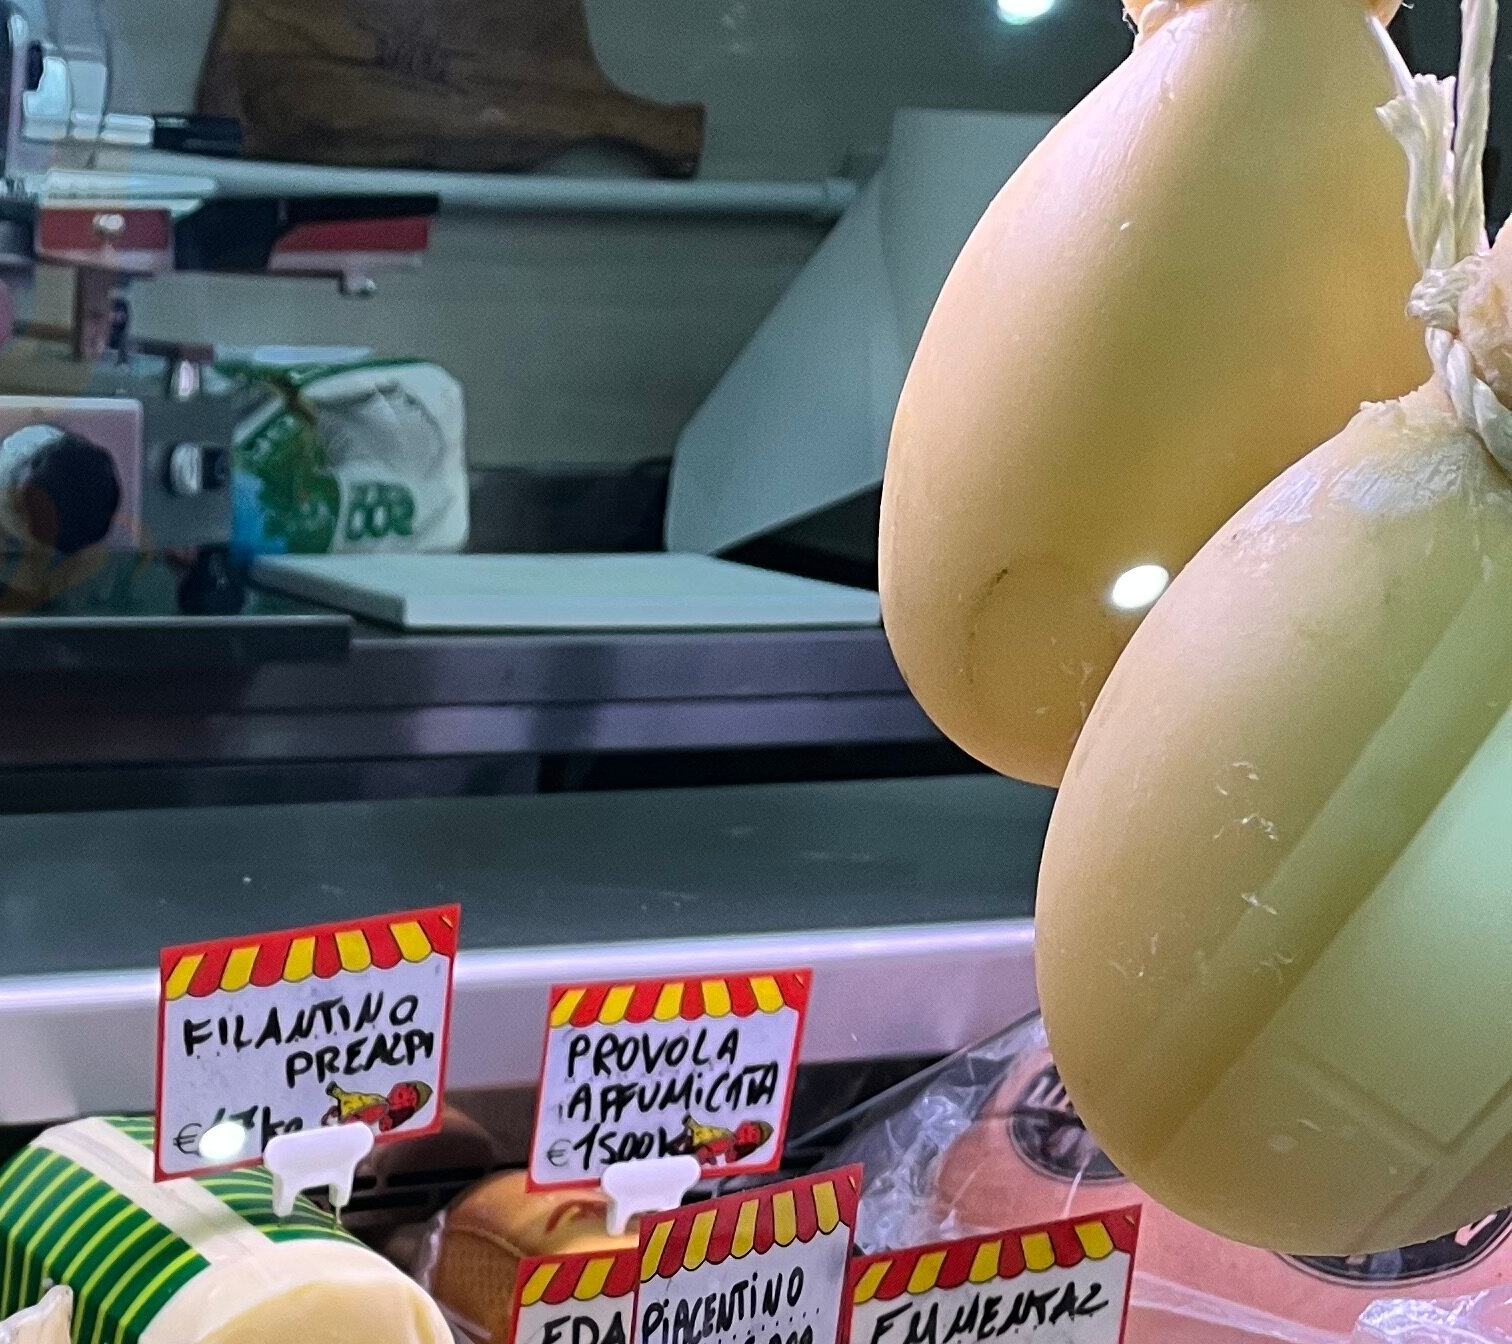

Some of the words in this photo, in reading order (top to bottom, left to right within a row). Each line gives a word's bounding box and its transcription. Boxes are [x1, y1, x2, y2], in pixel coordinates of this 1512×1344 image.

[182, 993, 418, 1059] FILANTINO
[566, 1027, 739, 1078] PROVOLA
[285, 1030, 434, 1088] PREALPI
